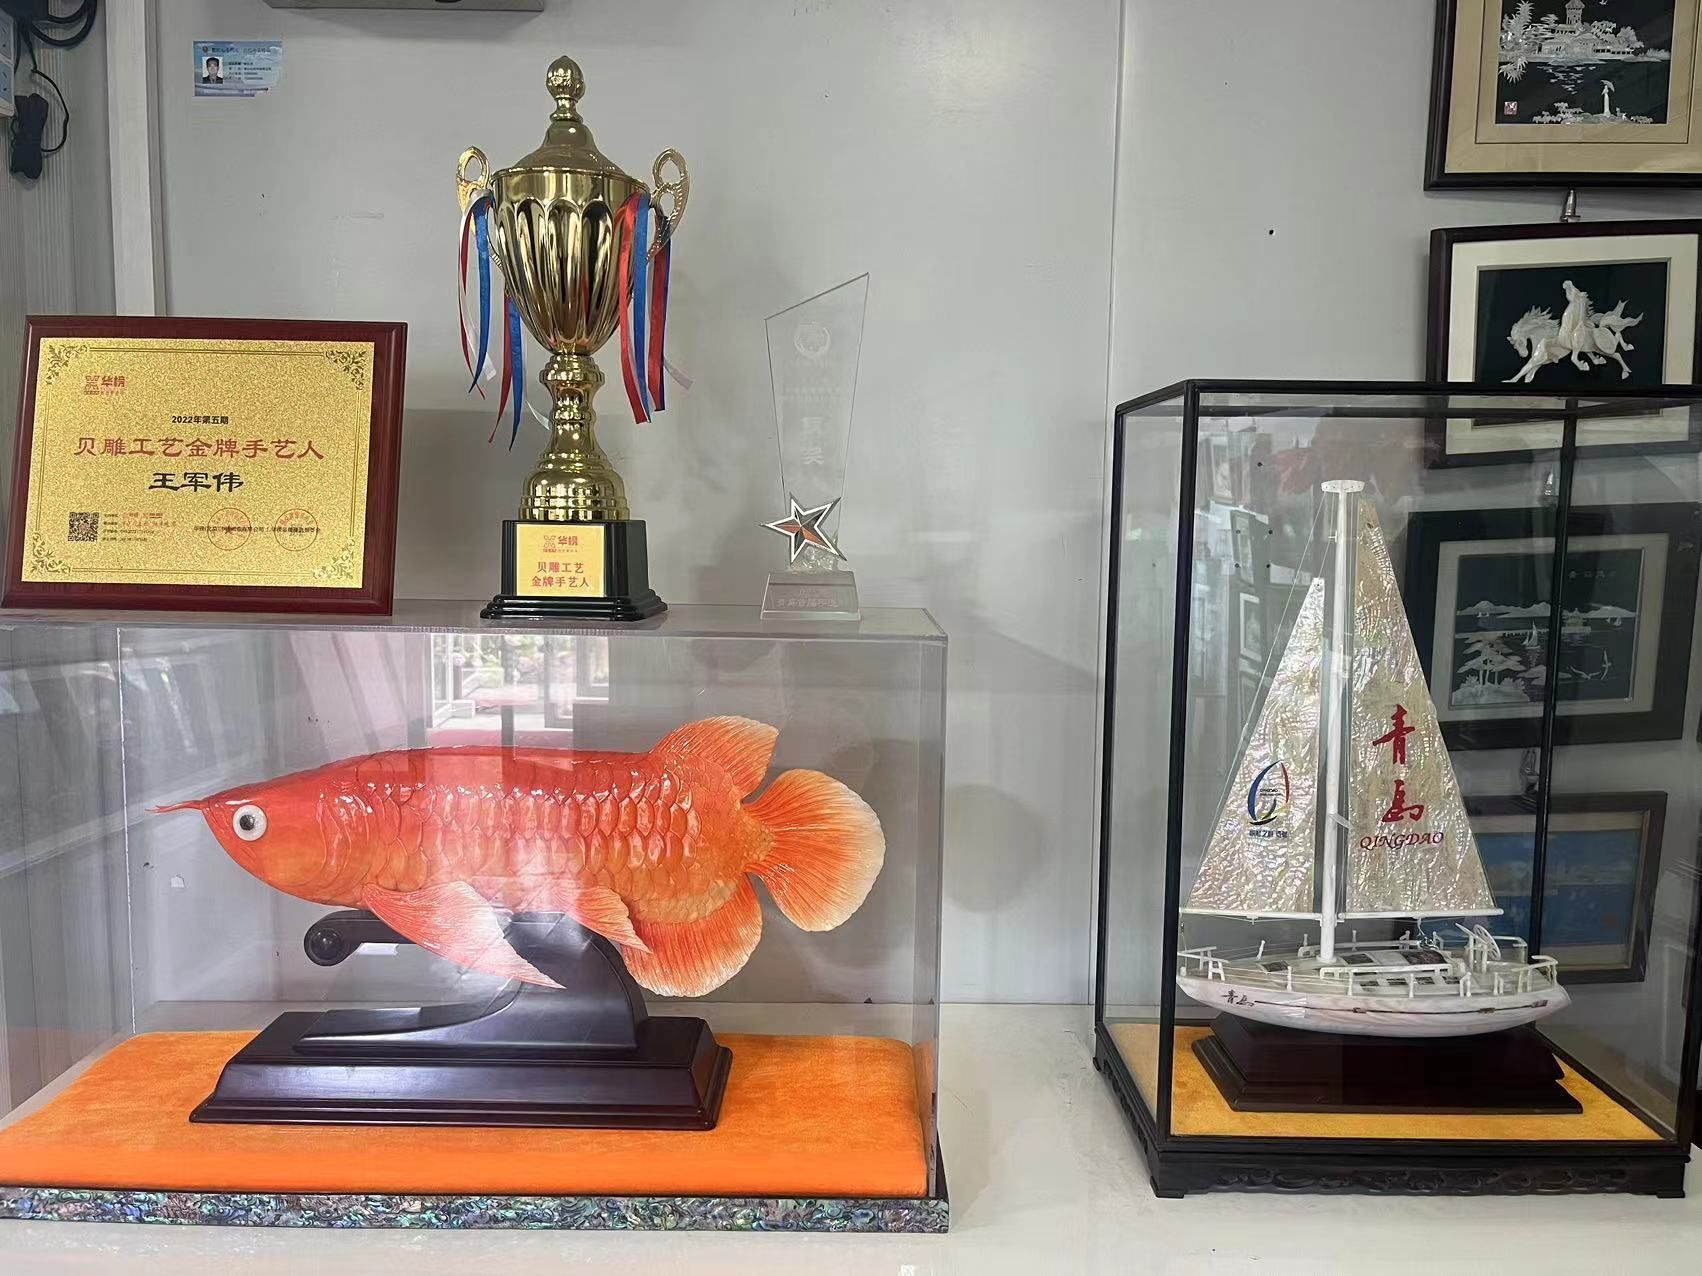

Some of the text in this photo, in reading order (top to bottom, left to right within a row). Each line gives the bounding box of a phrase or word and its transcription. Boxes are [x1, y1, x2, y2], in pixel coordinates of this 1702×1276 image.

[171, 415, 229, 425] 2022年第五期
[74, 437, 325, 460] 贝雕工艺金牌手艺人
[148, 472, 244, 493] 王军伟
[537, 561, 584, 573] 贝雕工艺
[532, 576, 589, 587] 金牌手艺人
[1372, 703, 1425, 823] 青岛
[1359, 831, 1445, 850] QINGDAO
